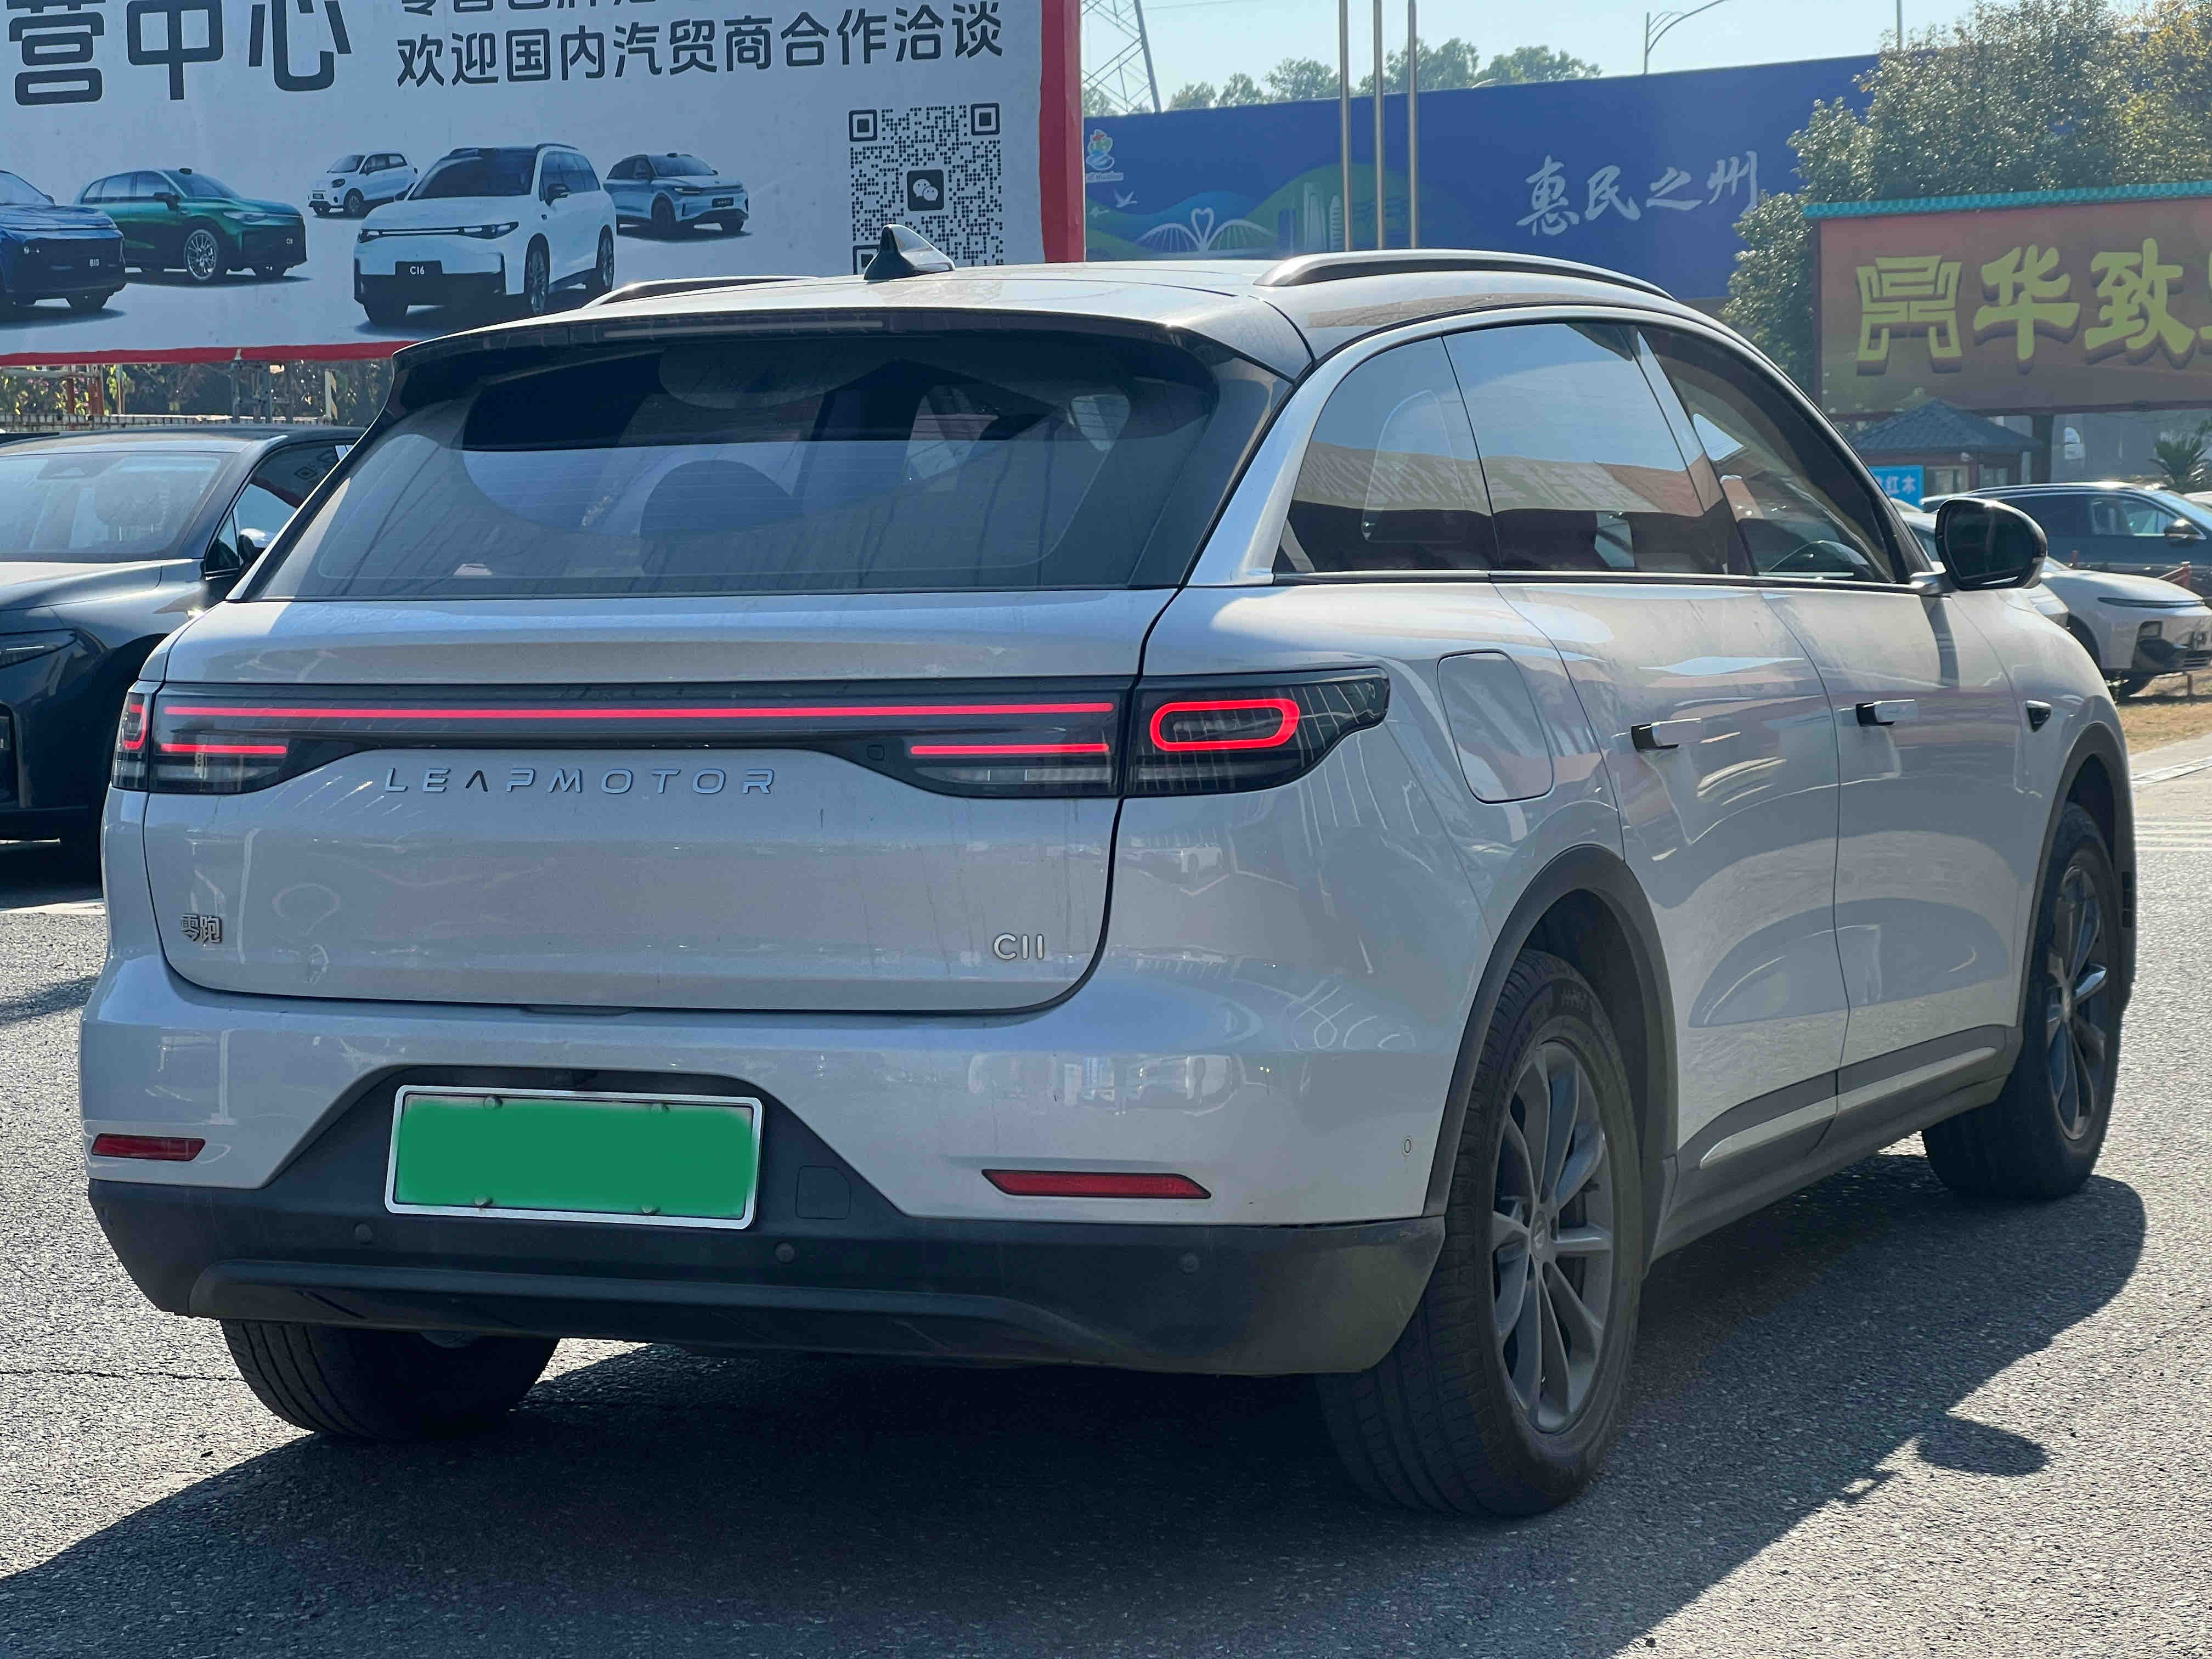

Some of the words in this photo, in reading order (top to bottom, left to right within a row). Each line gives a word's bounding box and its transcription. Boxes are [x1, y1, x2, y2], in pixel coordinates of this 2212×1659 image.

[7, 0, 352, 106] 营中心
[397, 1, 1003, 88] 欢迎国内汽贸商合作洽谈
[1516, 151, 1758, 236] 惠民之州
[409, 265, 425, 275] C16
[1974, 237, 2212, 375] 华致
[385, 767, 774, 794] LEAPMOTOR
[180, 913, 222, 944] 零跑
